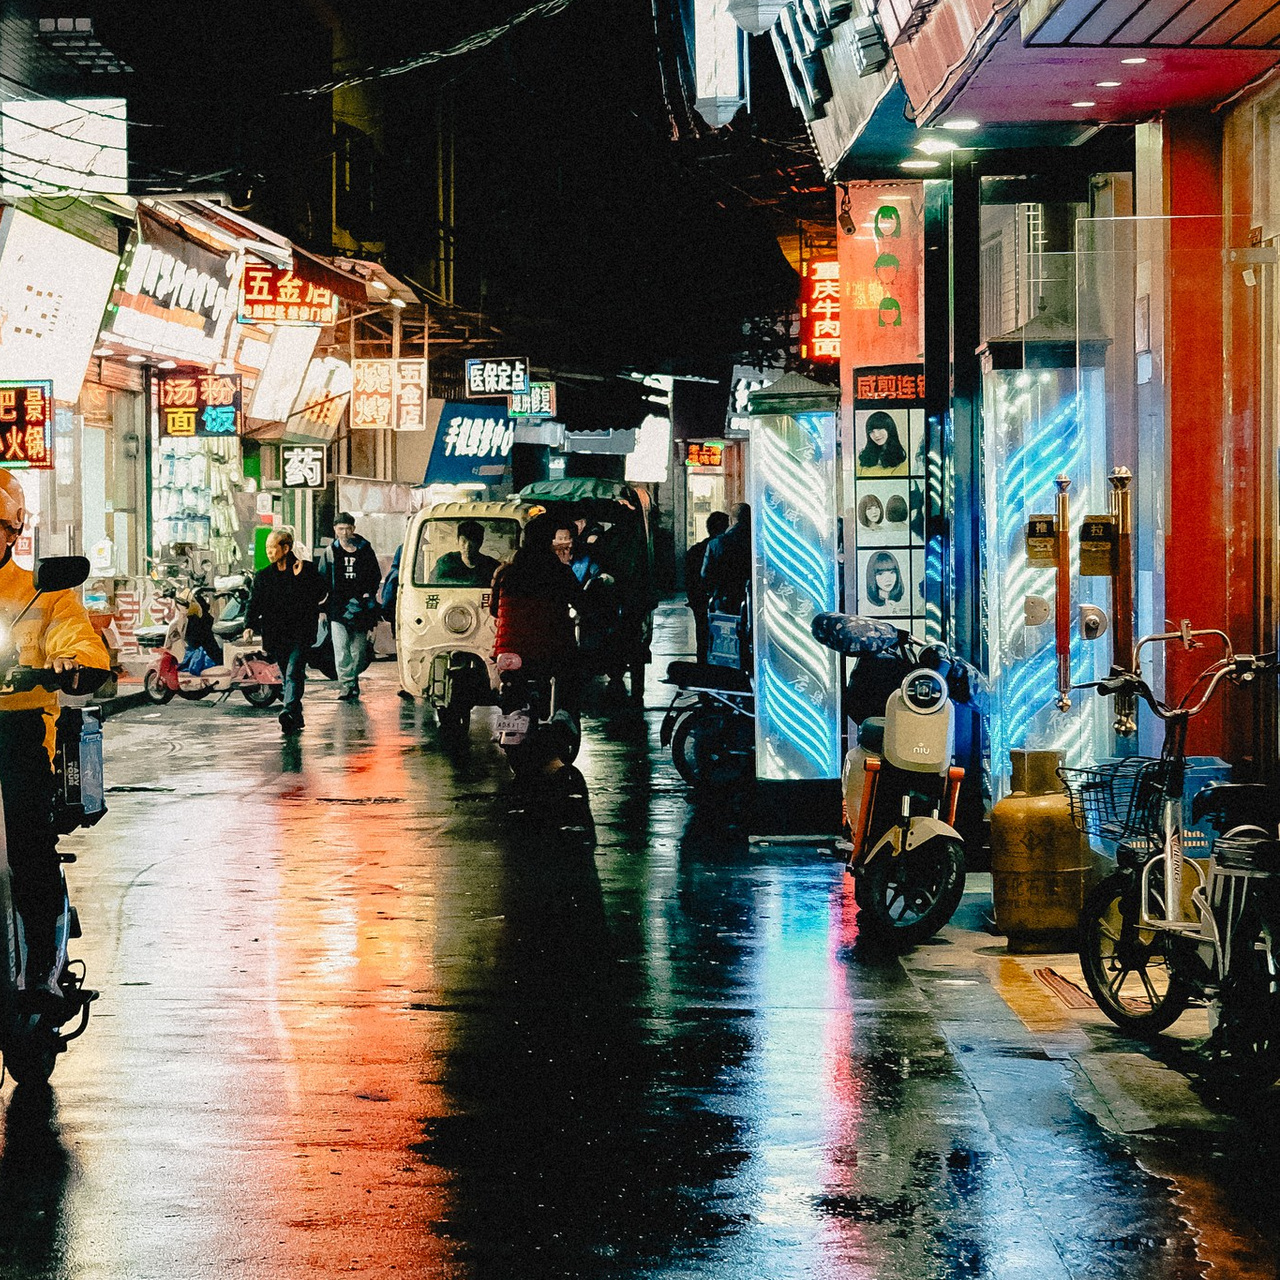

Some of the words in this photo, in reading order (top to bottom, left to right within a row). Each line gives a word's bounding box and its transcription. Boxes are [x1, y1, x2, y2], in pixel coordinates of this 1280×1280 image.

[812, 261, 841, 358] 重庆牛肉面
[165, 375, 237, 406] 汤粉
[470, 361, 525, 392] 医保定点
[355, 363, 392, 425] 烧烤
[400, 365, 424, 429] 五金店
[165, 406, 237, 436] 面饭
[284, 448, 322, 486] 药
[1091, 524, 1104, 536] 拉
